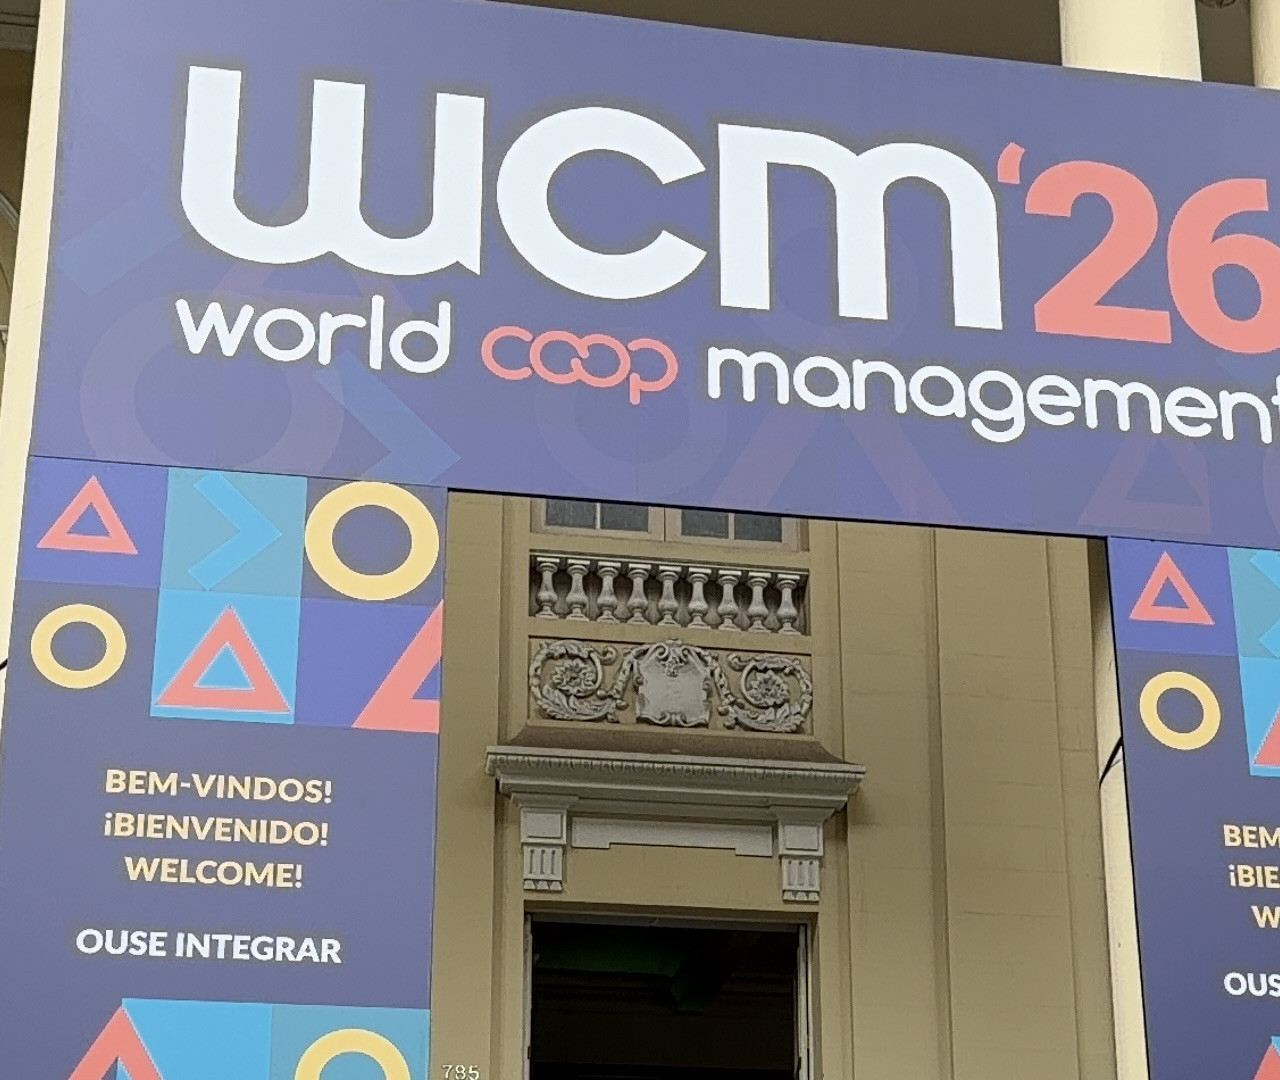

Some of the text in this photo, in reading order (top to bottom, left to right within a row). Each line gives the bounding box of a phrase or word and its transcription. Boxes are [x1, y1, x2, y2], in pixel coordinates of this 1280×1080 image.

[174, 295, 452, 374] world
[482, 327, 678, 403] coop
[105, 769, 332, 805] BEM-VINDOS!
[104, 811, 329, 847] ¡BIENVENIDO!
[123, 855, 303, 889] WELCOME!
[75, 928, 342, 964] OUSE INTEGRAR
